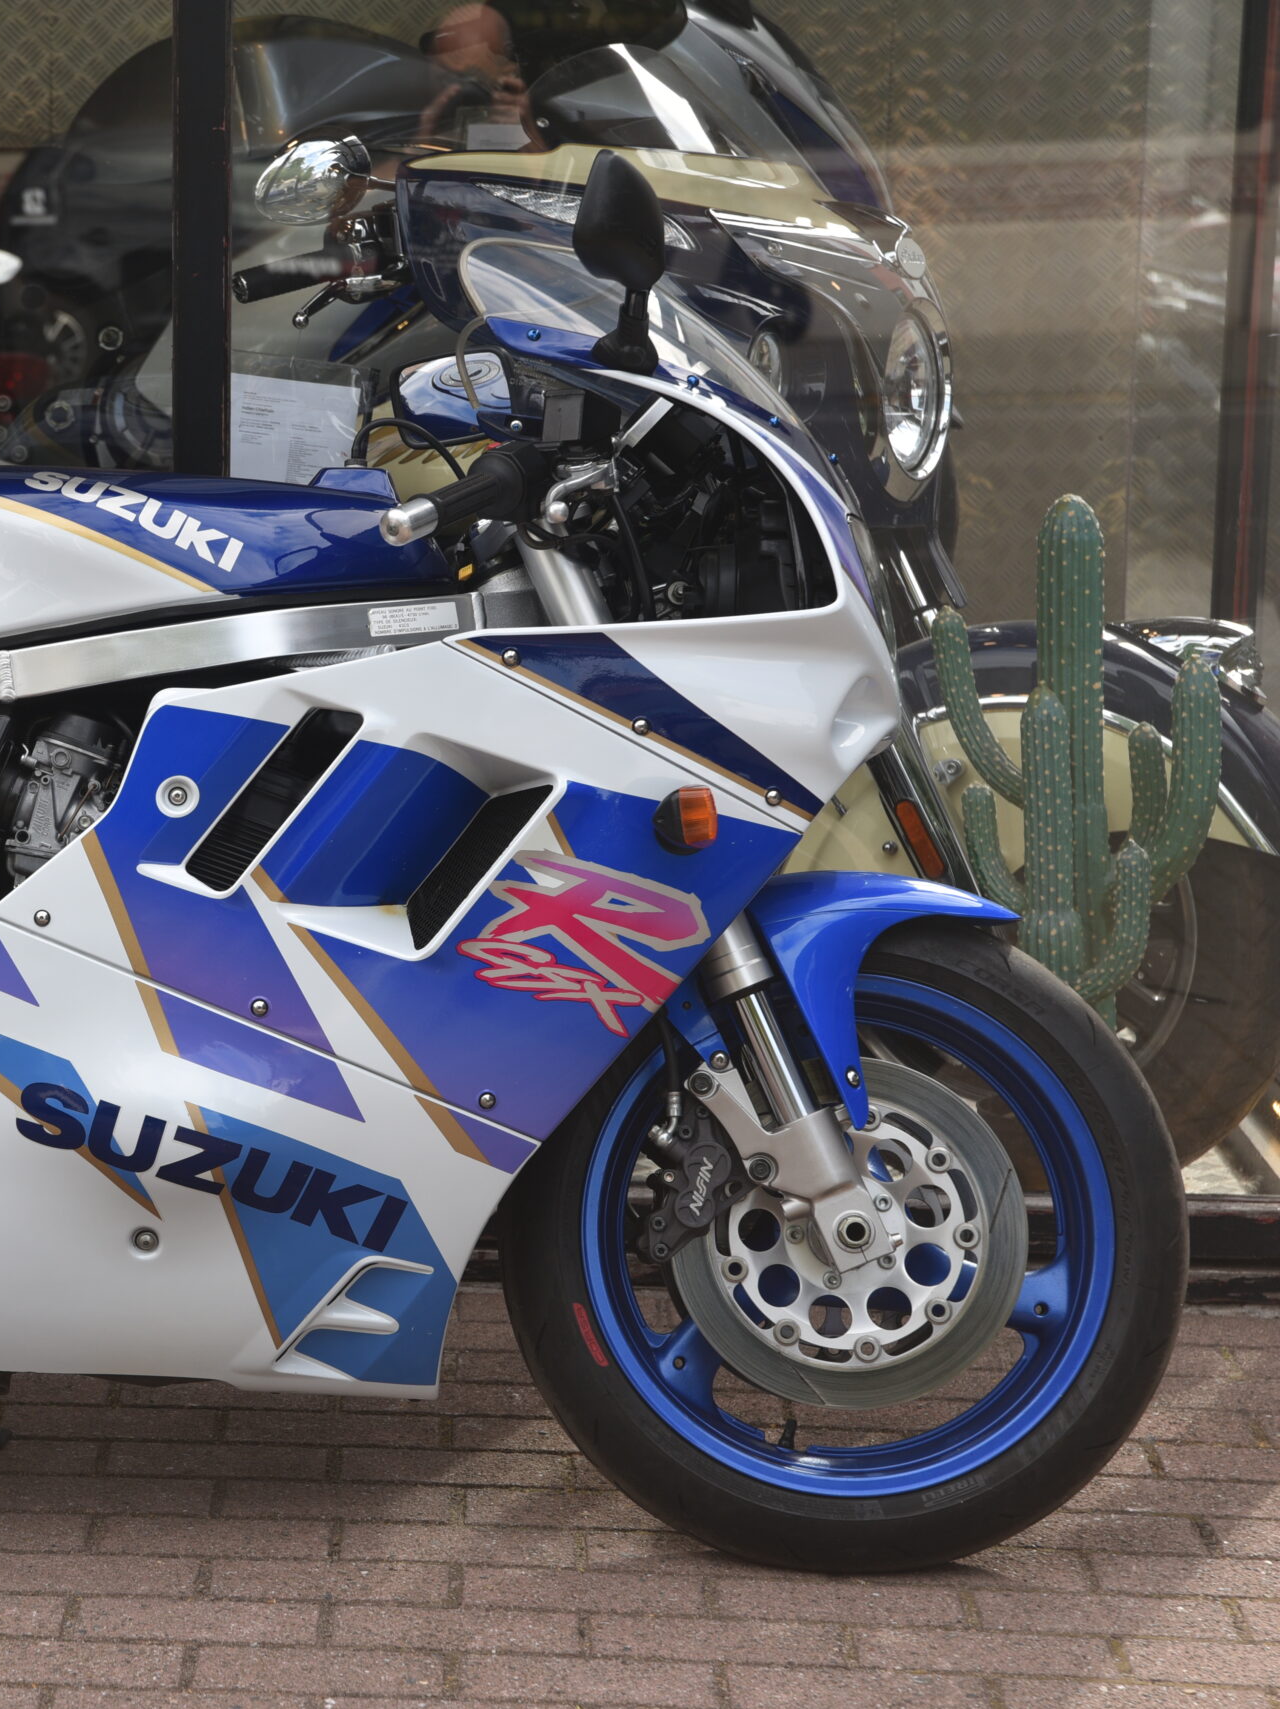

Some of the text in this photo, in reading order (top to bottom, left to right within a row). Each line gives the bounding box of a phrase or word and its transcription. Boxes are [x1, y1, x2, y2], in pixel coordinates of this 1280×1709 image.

[24, 471, 244, 573] SUZUKI
[477, 849, 711, 1014] R
[456, 938, 645, 1038] GSX
[16, 1082, 408, 1253] SUZUKI
[689, 1156, 714, 1217] NISSIN
